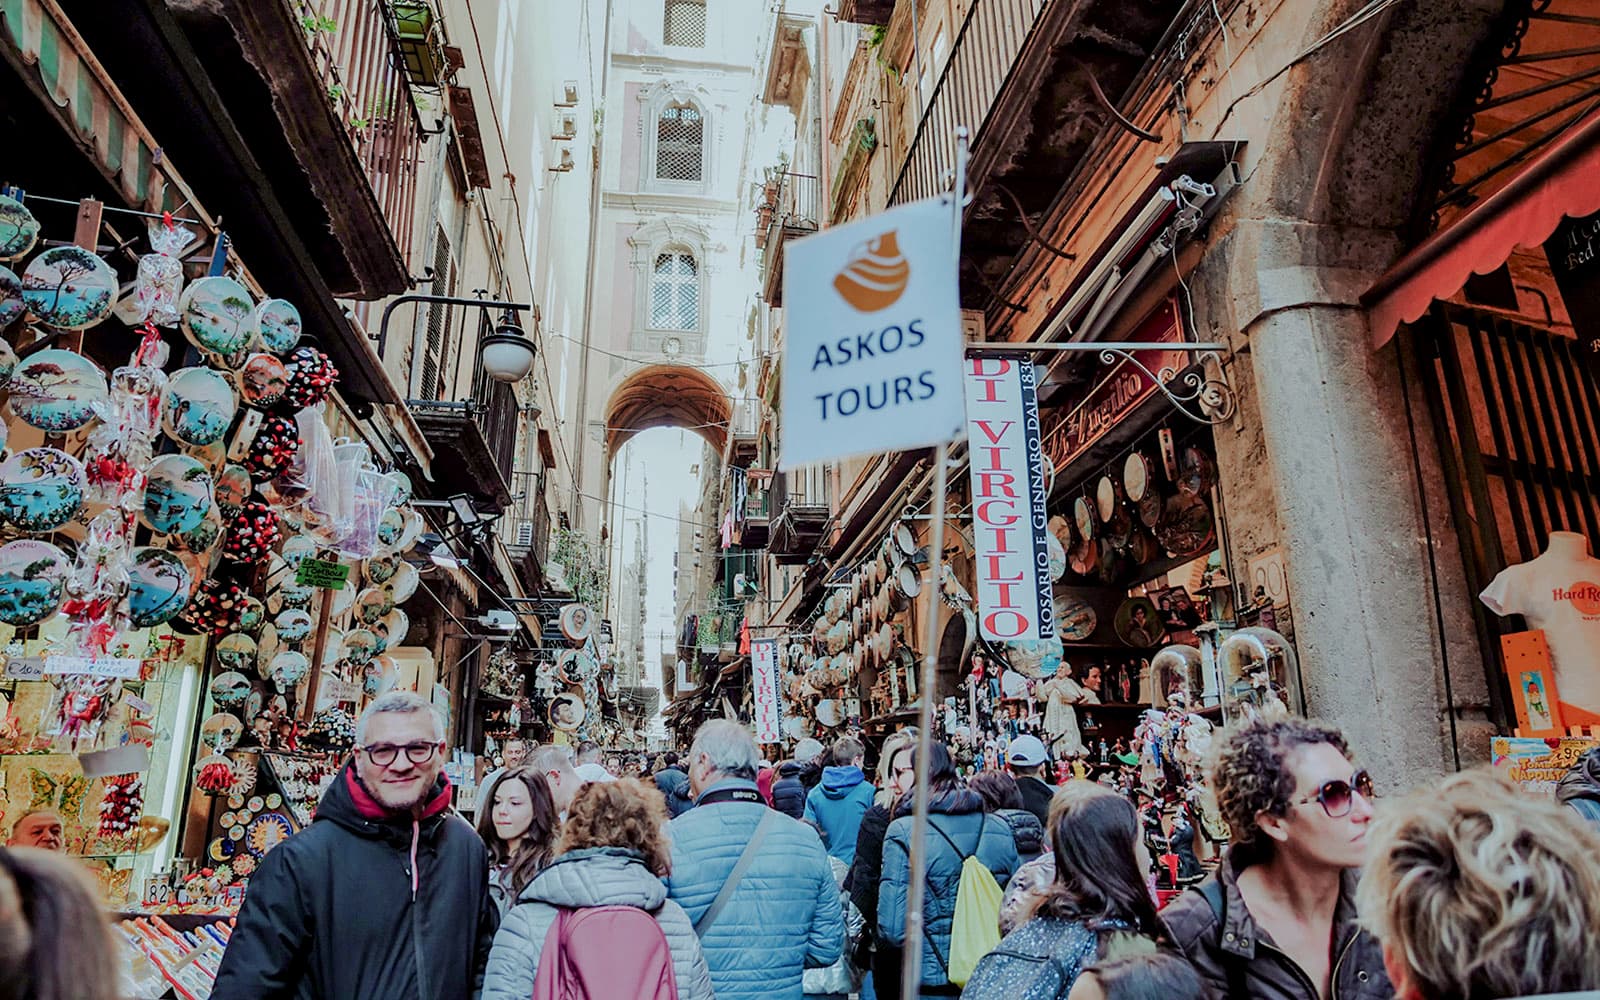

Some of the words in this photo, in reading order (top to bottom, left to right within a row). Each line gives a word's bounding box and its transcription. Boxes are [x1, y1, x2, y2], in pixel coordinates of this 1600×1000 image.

[811, 318, 925, 371] ASKOS
[815, 370, 936, 421] TOURS
[968, 359, 1010, 402] DI
[1025, 398, 1039, 430] DAL
[1029, 437, 1046, 529] GENNARO
[970, 420, 1029, 637] VIRGILIO
[1036, 536, 1047, 545] E
[1037, 552, 1054, 635] ROSARIO
[1551, 587, 1585, 601] Hard
[757, 667, 777, 740] VIRGILIO
